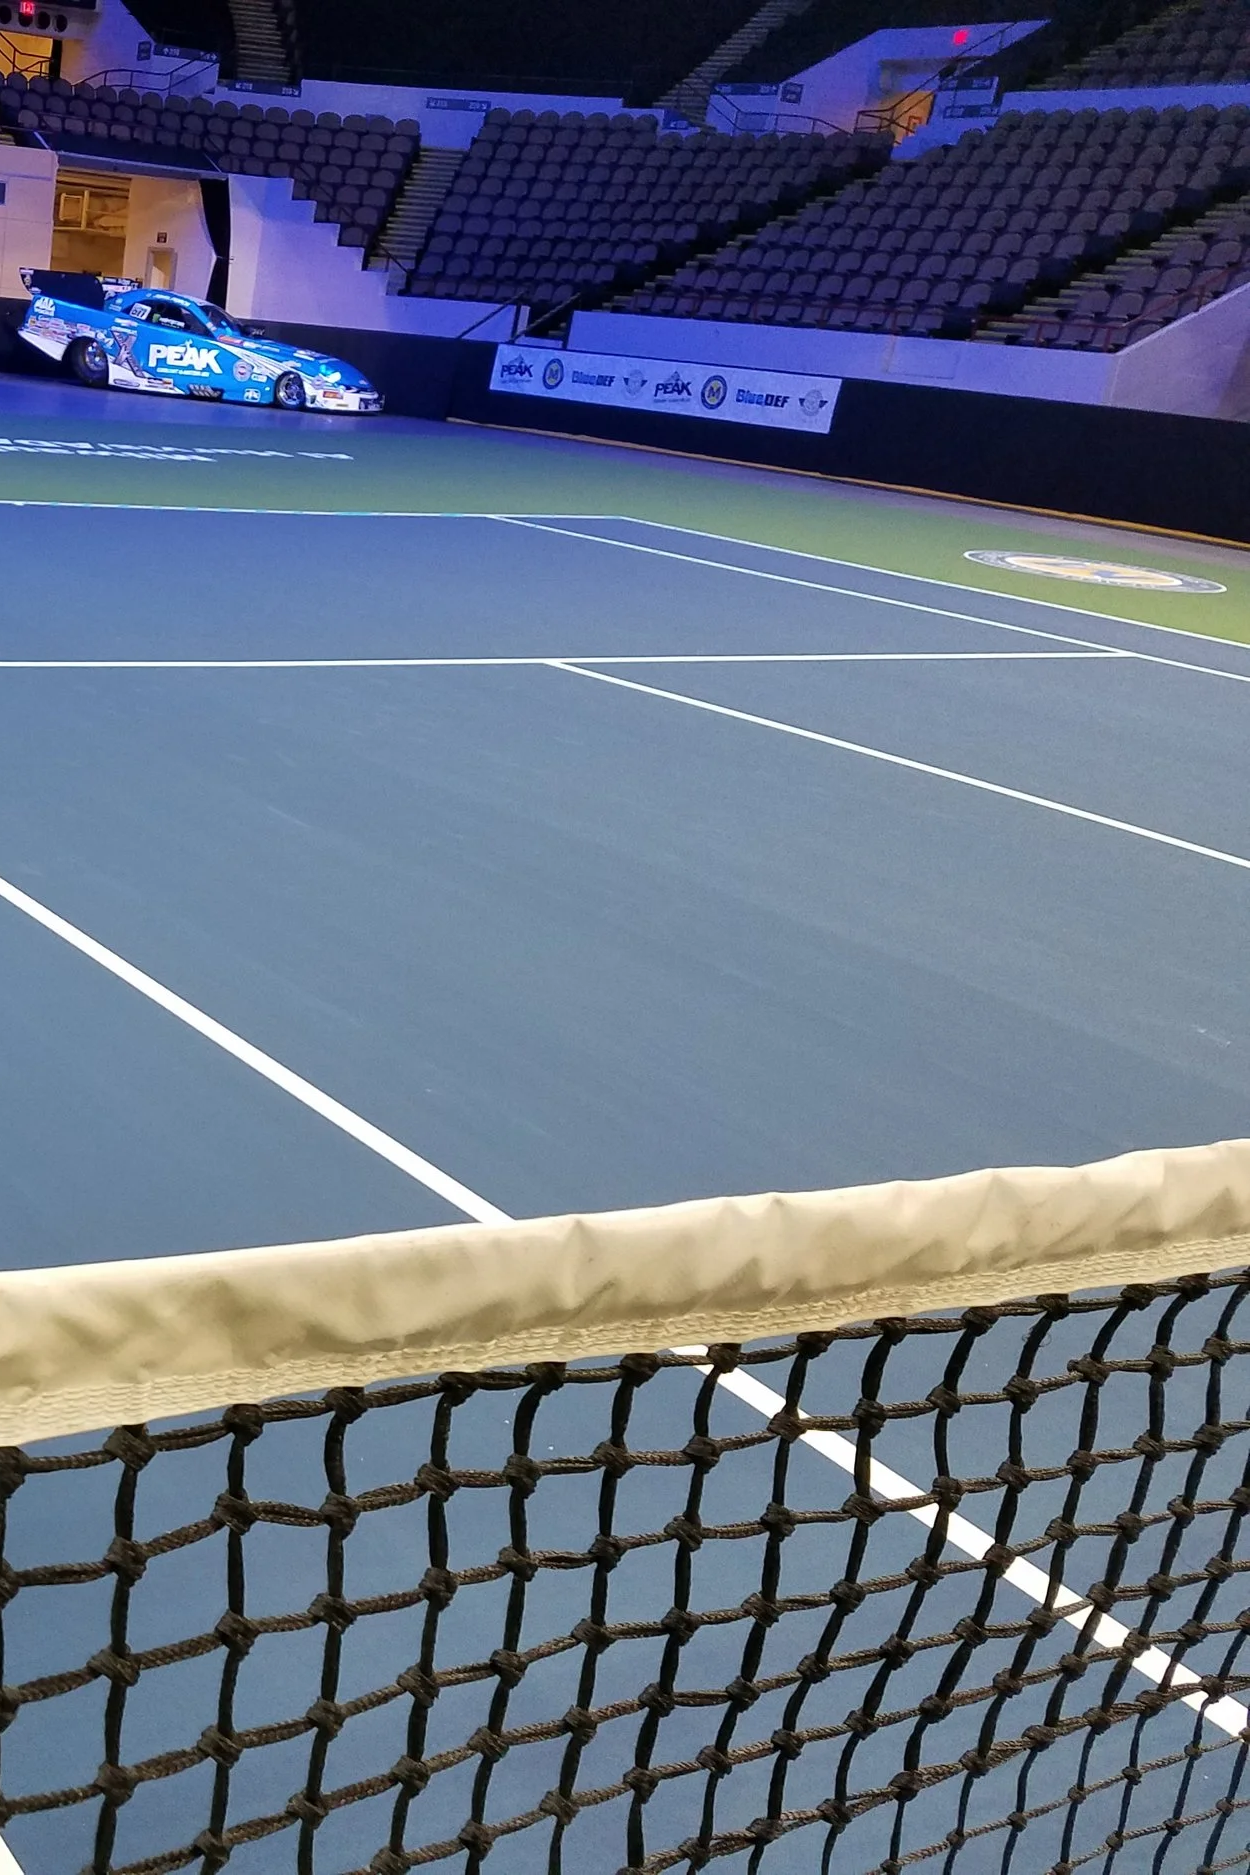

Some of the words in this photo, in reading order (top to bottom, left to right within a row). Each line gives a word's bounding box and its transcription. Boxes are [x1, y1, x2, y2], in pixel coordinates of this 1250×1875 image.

[148, 342, 223, 374] PEAK
[500, 363, 534, 379] PEAK
[653, 381, 692, 397] PEAK
